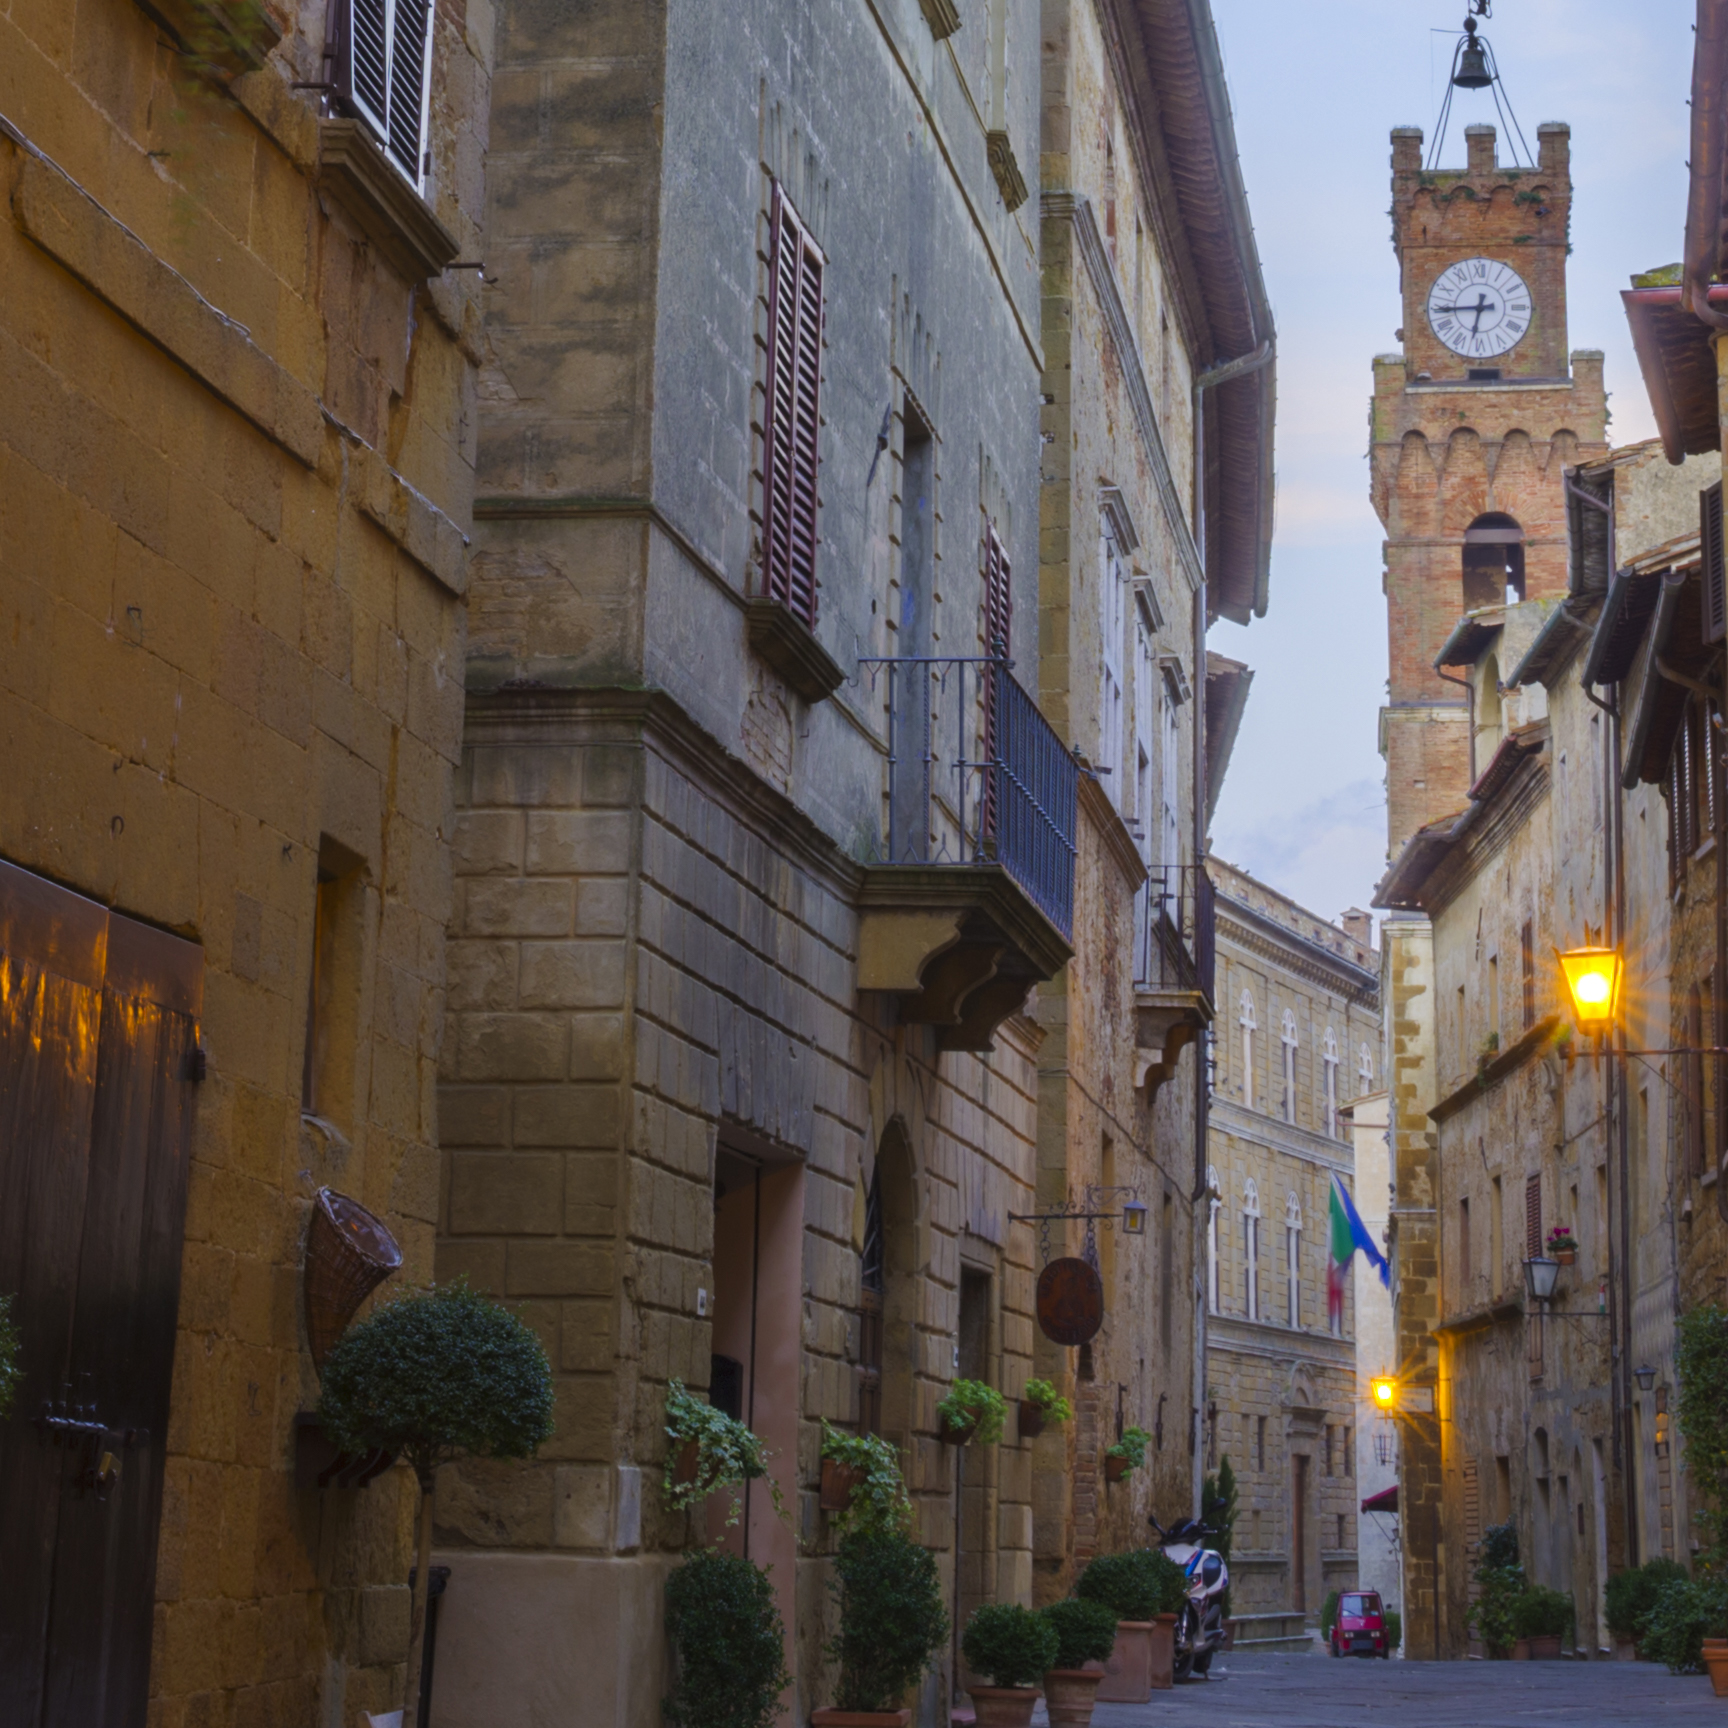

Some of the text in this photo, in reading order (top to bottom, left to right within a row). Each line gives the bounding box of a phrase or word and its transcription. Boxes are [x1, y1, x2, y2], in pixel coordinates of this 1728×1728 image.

[1452, 267, 1467, 285] XI
[1473, 263, 1486, 278] XII
[1438, 283, 1455, 297] X
[1437, 318, 1455, 337] VIII
[1452, 332, 1467, 349] VII
[1475, 337, 1486, 352] VI
[1495, 333, 1507, 348] V
